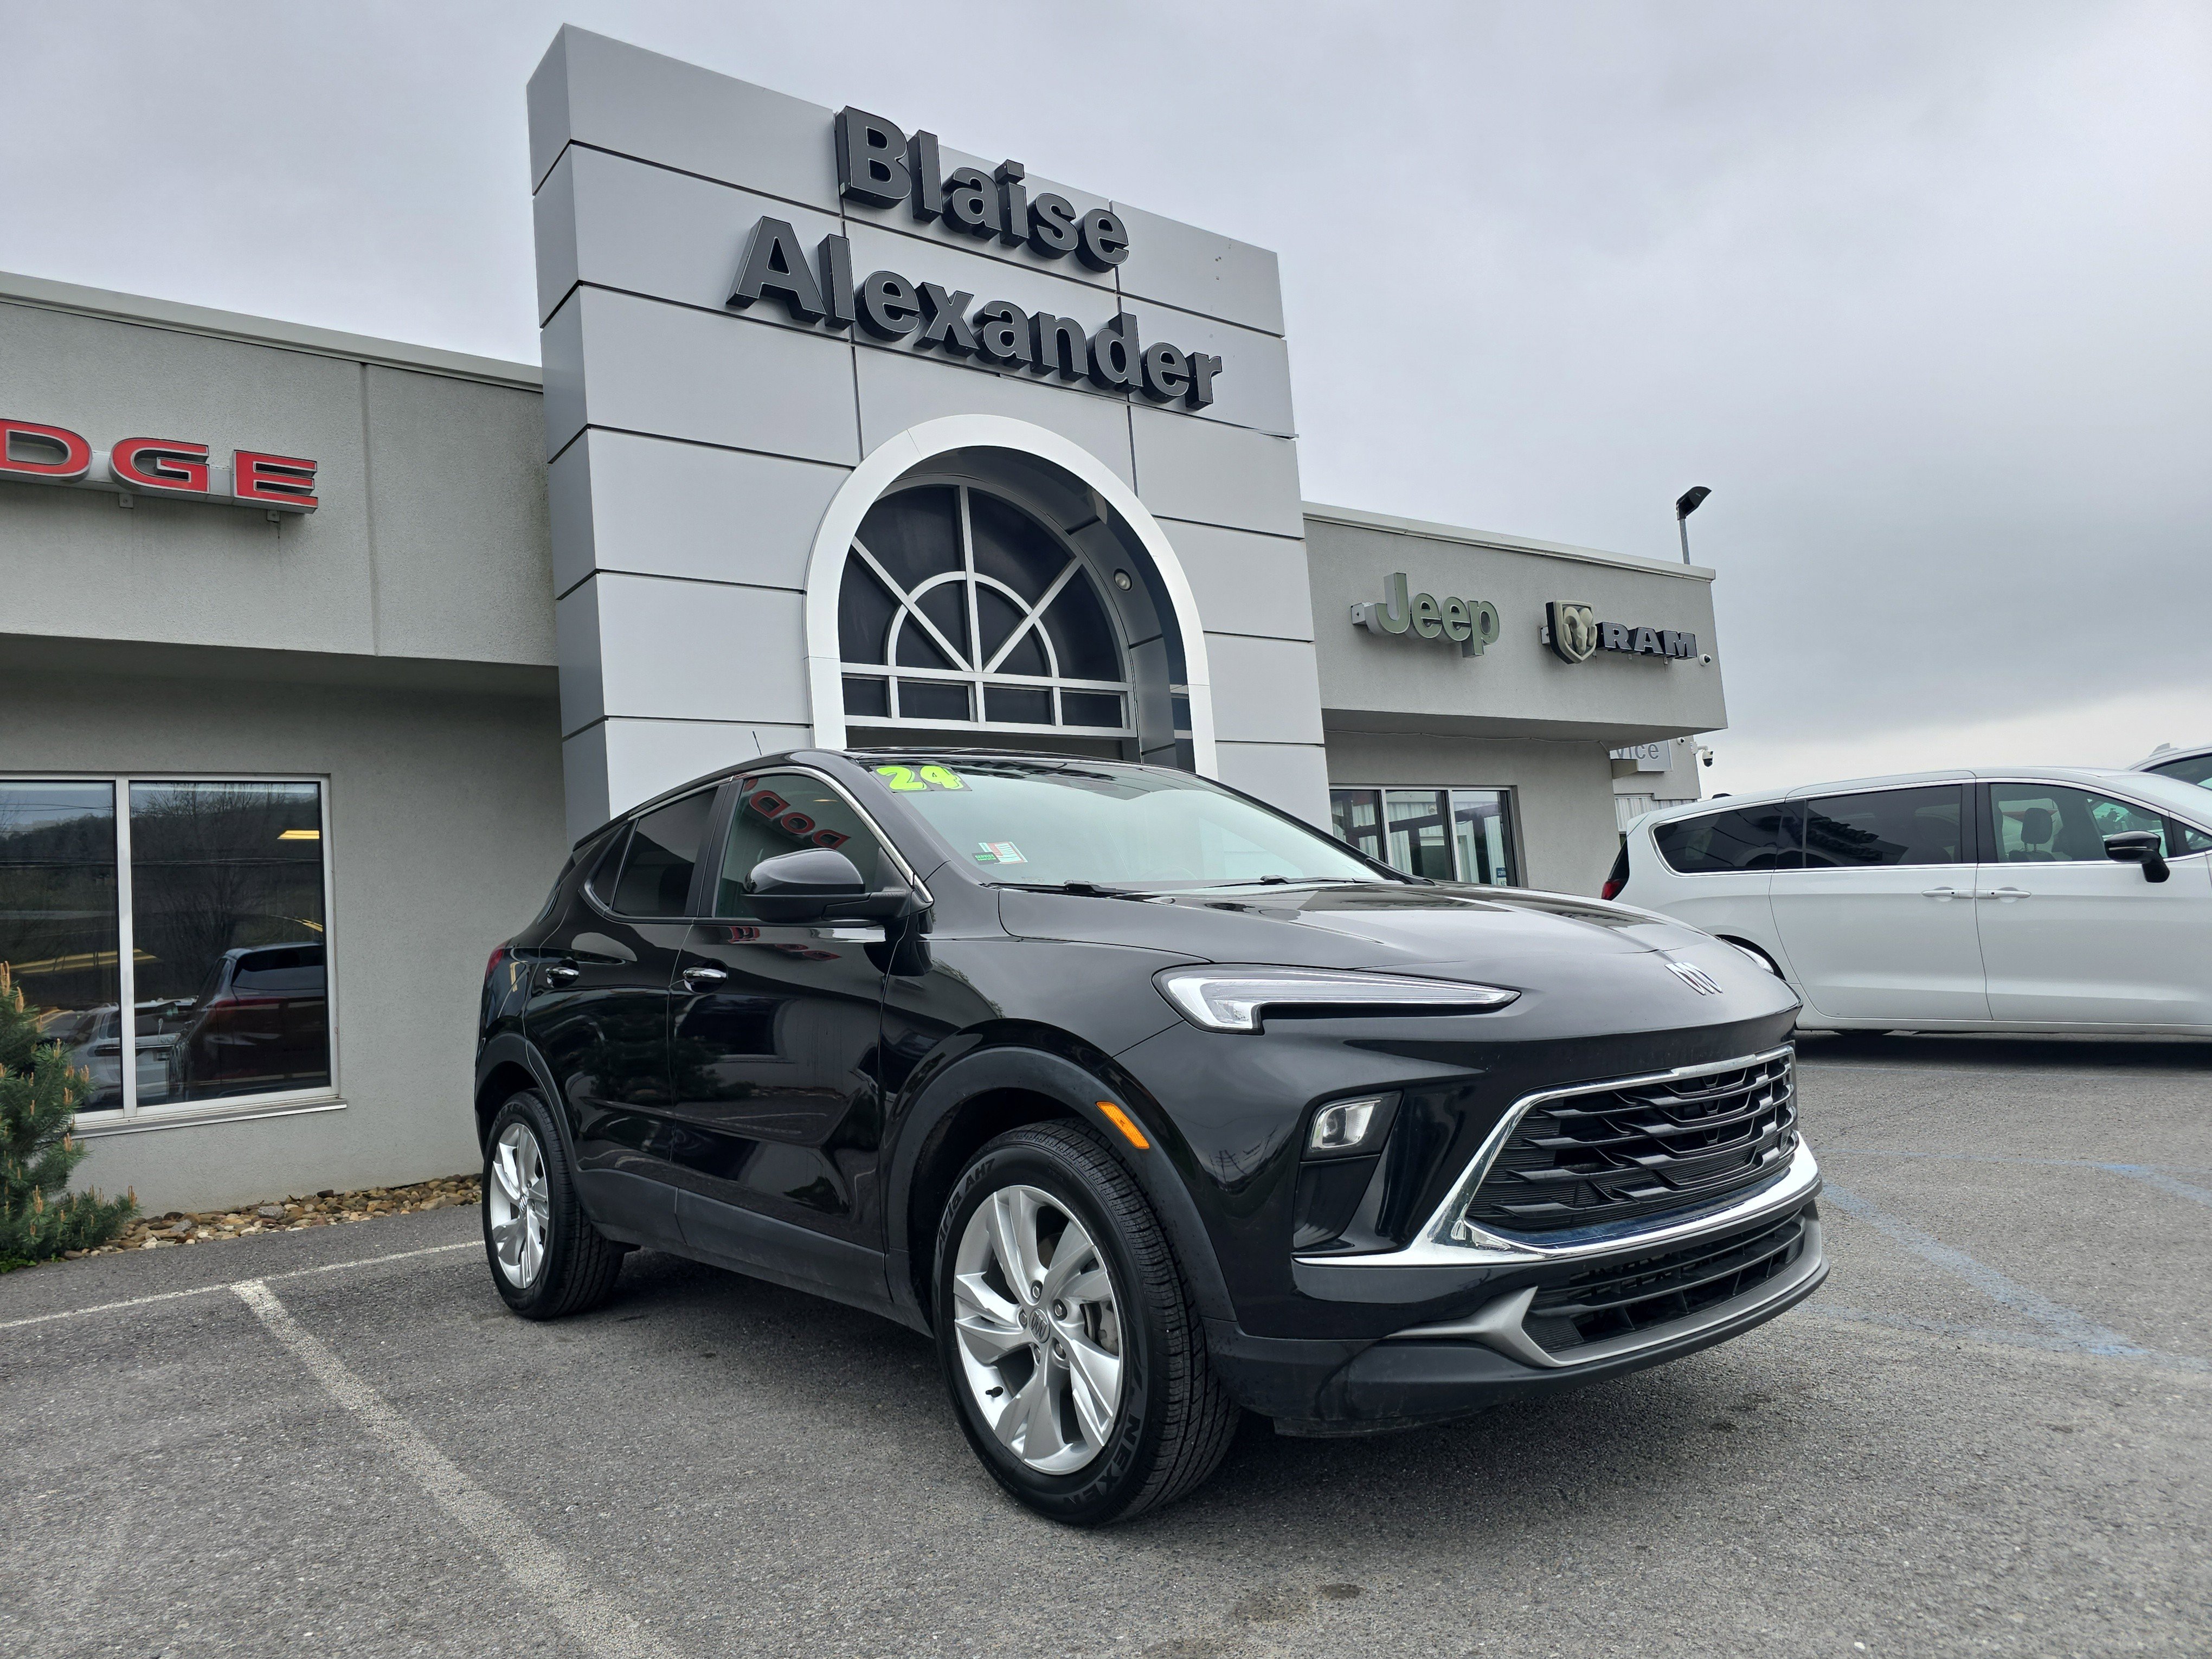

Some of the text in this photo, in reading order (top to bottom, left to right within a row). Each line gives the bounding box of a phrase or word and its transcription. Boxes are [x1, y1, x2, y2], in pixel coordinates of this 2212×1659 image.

[834, 106, 1129, 272] Blaise
[726, 216, 1222, 410] Alexander
[1365, 573, 1500, 658] Jeep
[1595, 621, 1697, 660] RAM
[876, 765, 964, 790] 24
[964, 1158, 995, 1193] AH7
[1063, 1412, 1141, 1506] NEXEN
